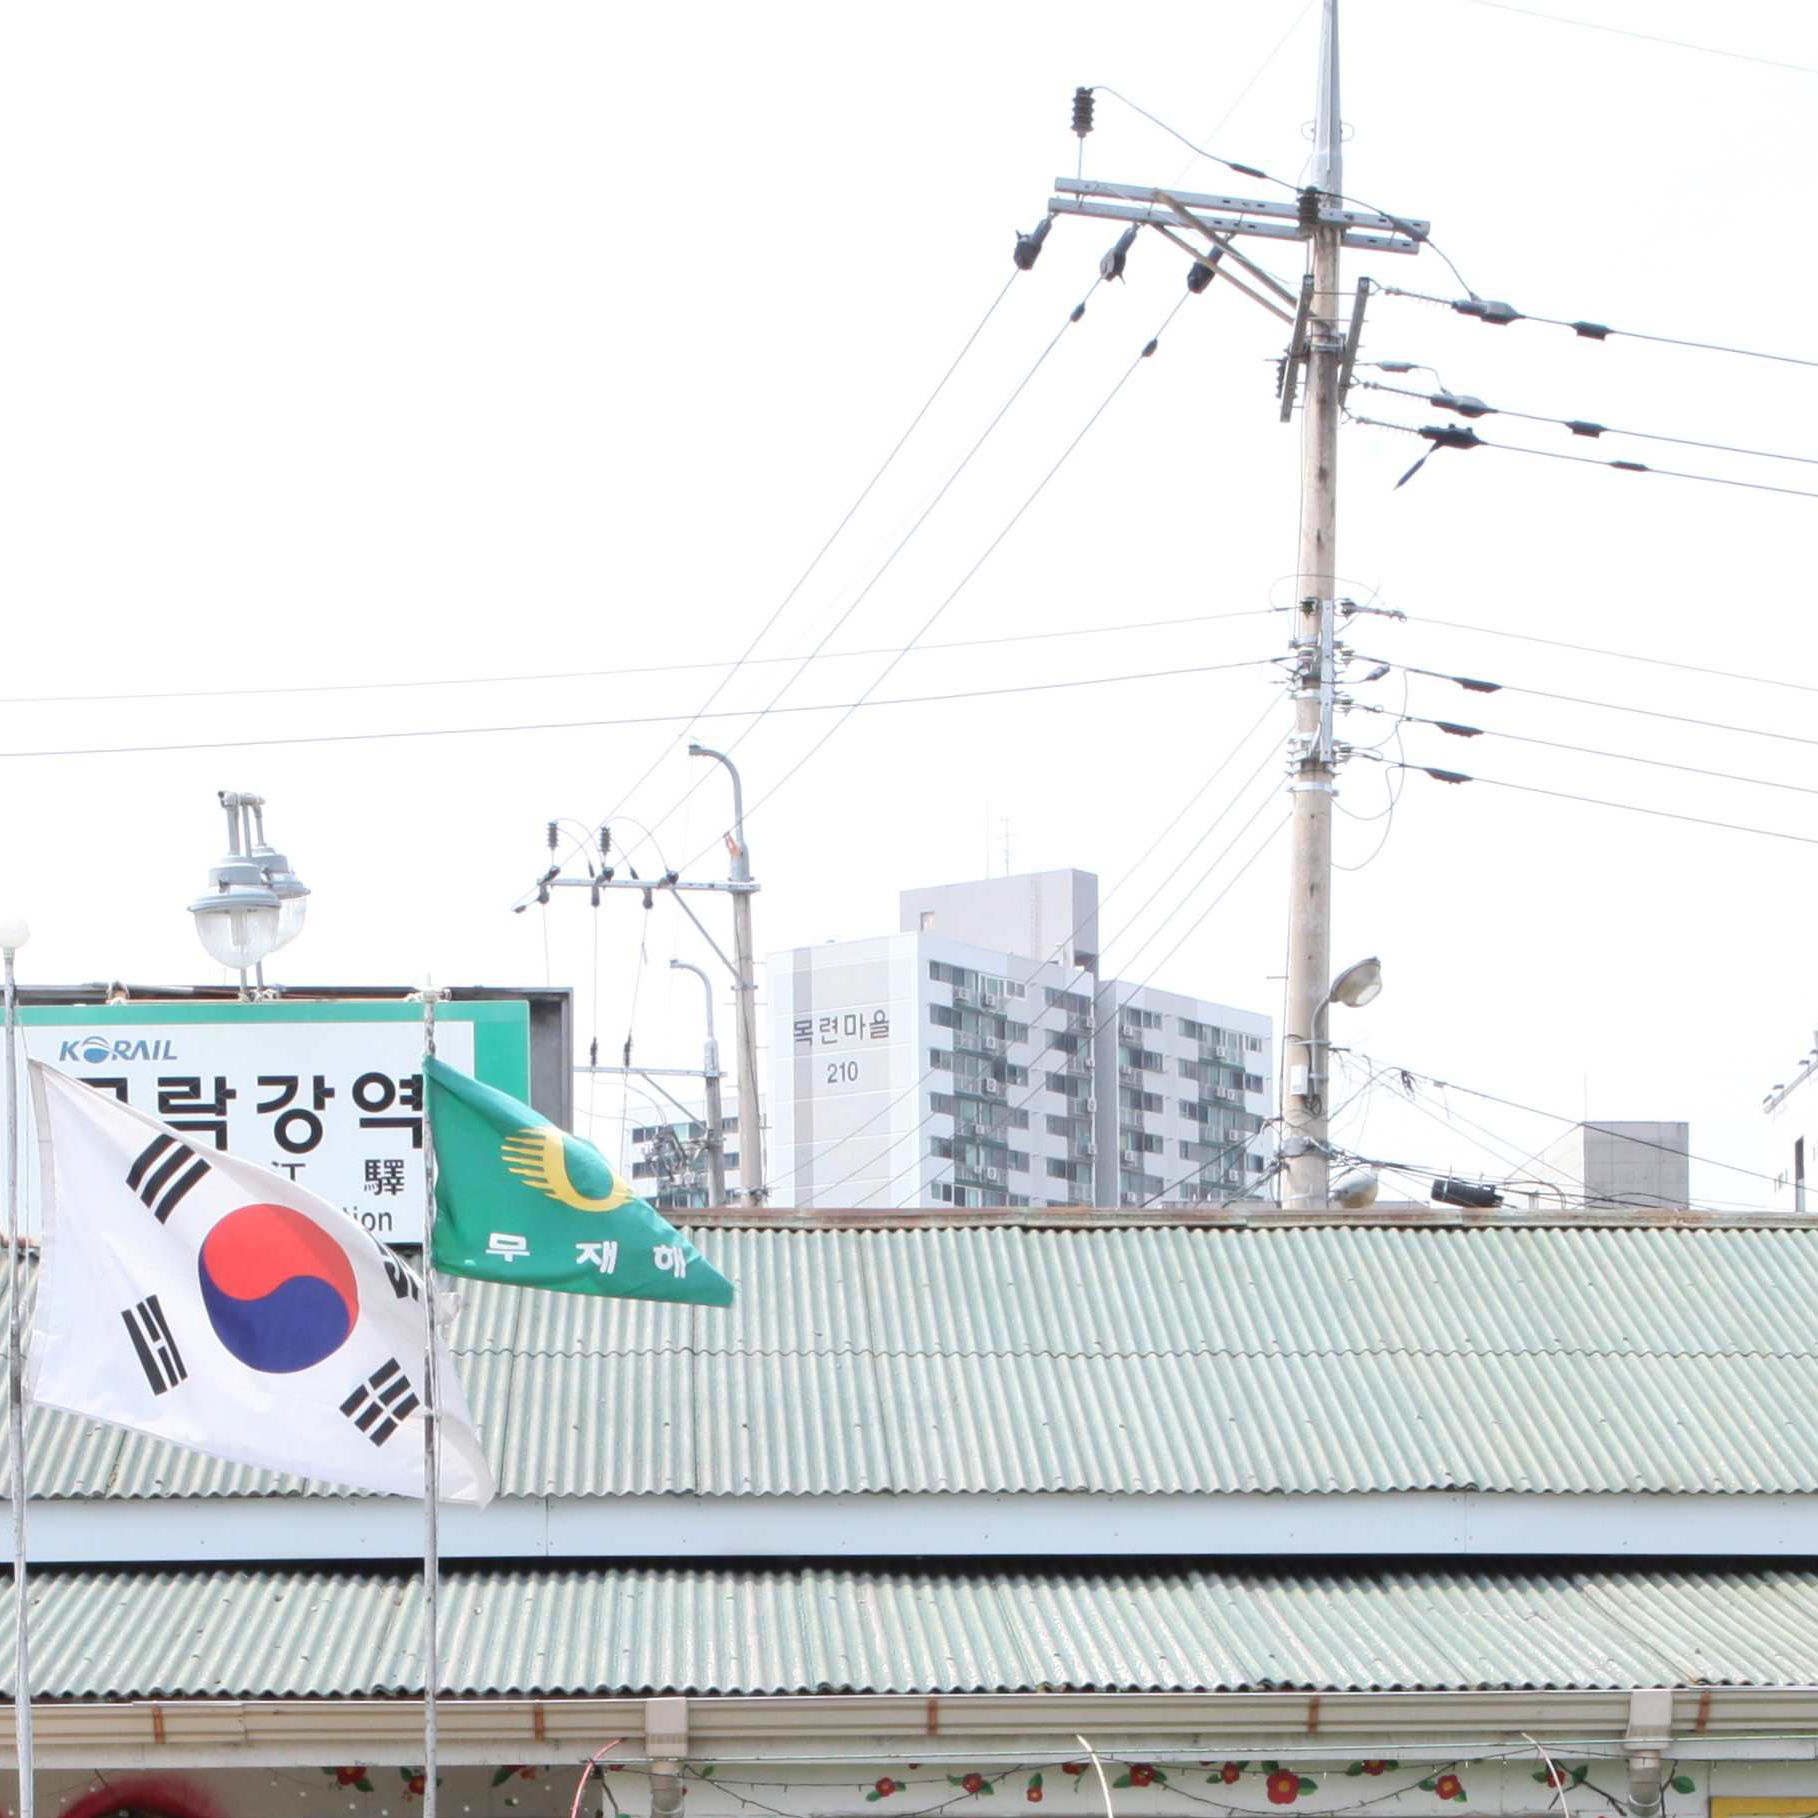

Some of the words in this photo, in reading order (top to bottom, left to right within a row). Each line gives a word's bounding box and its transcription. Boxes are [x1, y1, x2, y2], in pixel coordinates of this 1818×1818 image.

[794, 1009, 890, 1047] 목련마을
[59, 1035, 178, 1064] KORAIL
[827, 1061, 859, 1084] 210
